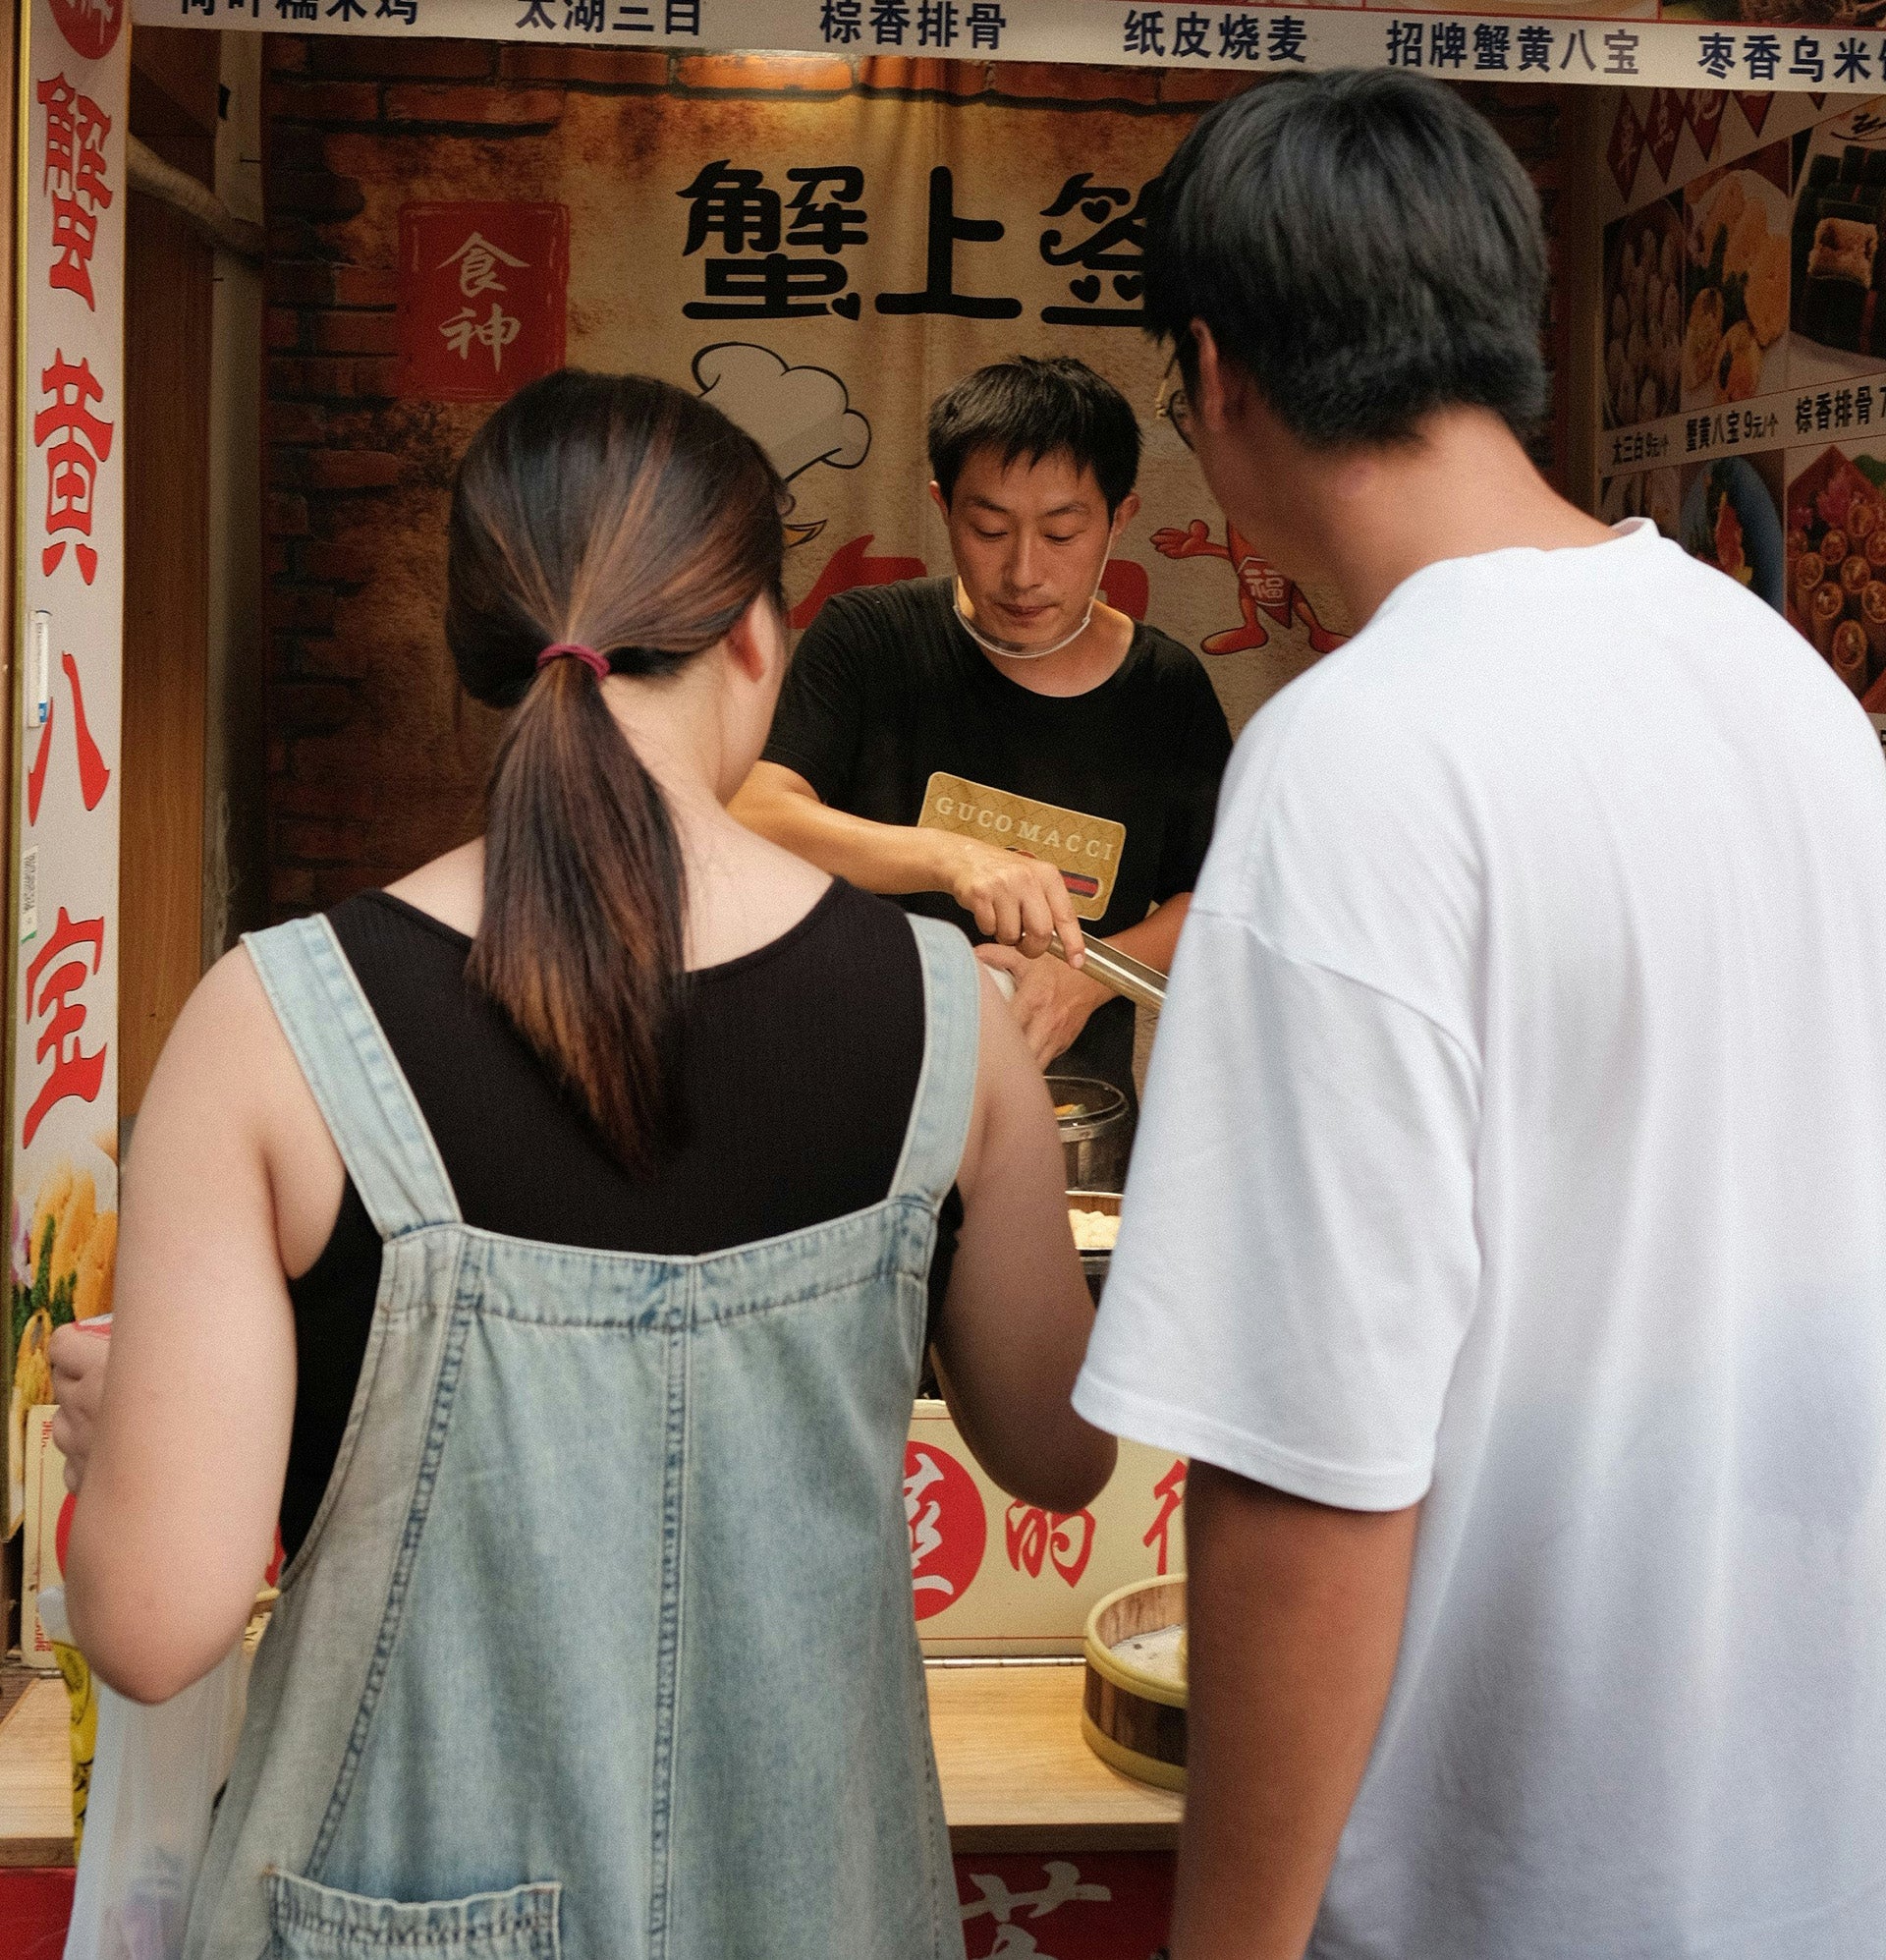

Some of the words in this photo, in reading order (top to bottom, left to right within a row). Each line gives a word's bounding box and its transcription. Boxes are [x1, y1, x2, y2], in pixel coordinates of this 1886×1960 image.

[819, 0, 1007, 50] 棕香排骨
[1123, 9, 1307, 62] 纸皮烧麦
[1386, 20, 1639, 75] 招牌蟹黄八宝
[1697, 31, 1886, 84] 枣香乌米
[437, 231, 530, 372] 食神
[24, 72, 114, 1149] 蟹黄八宝
